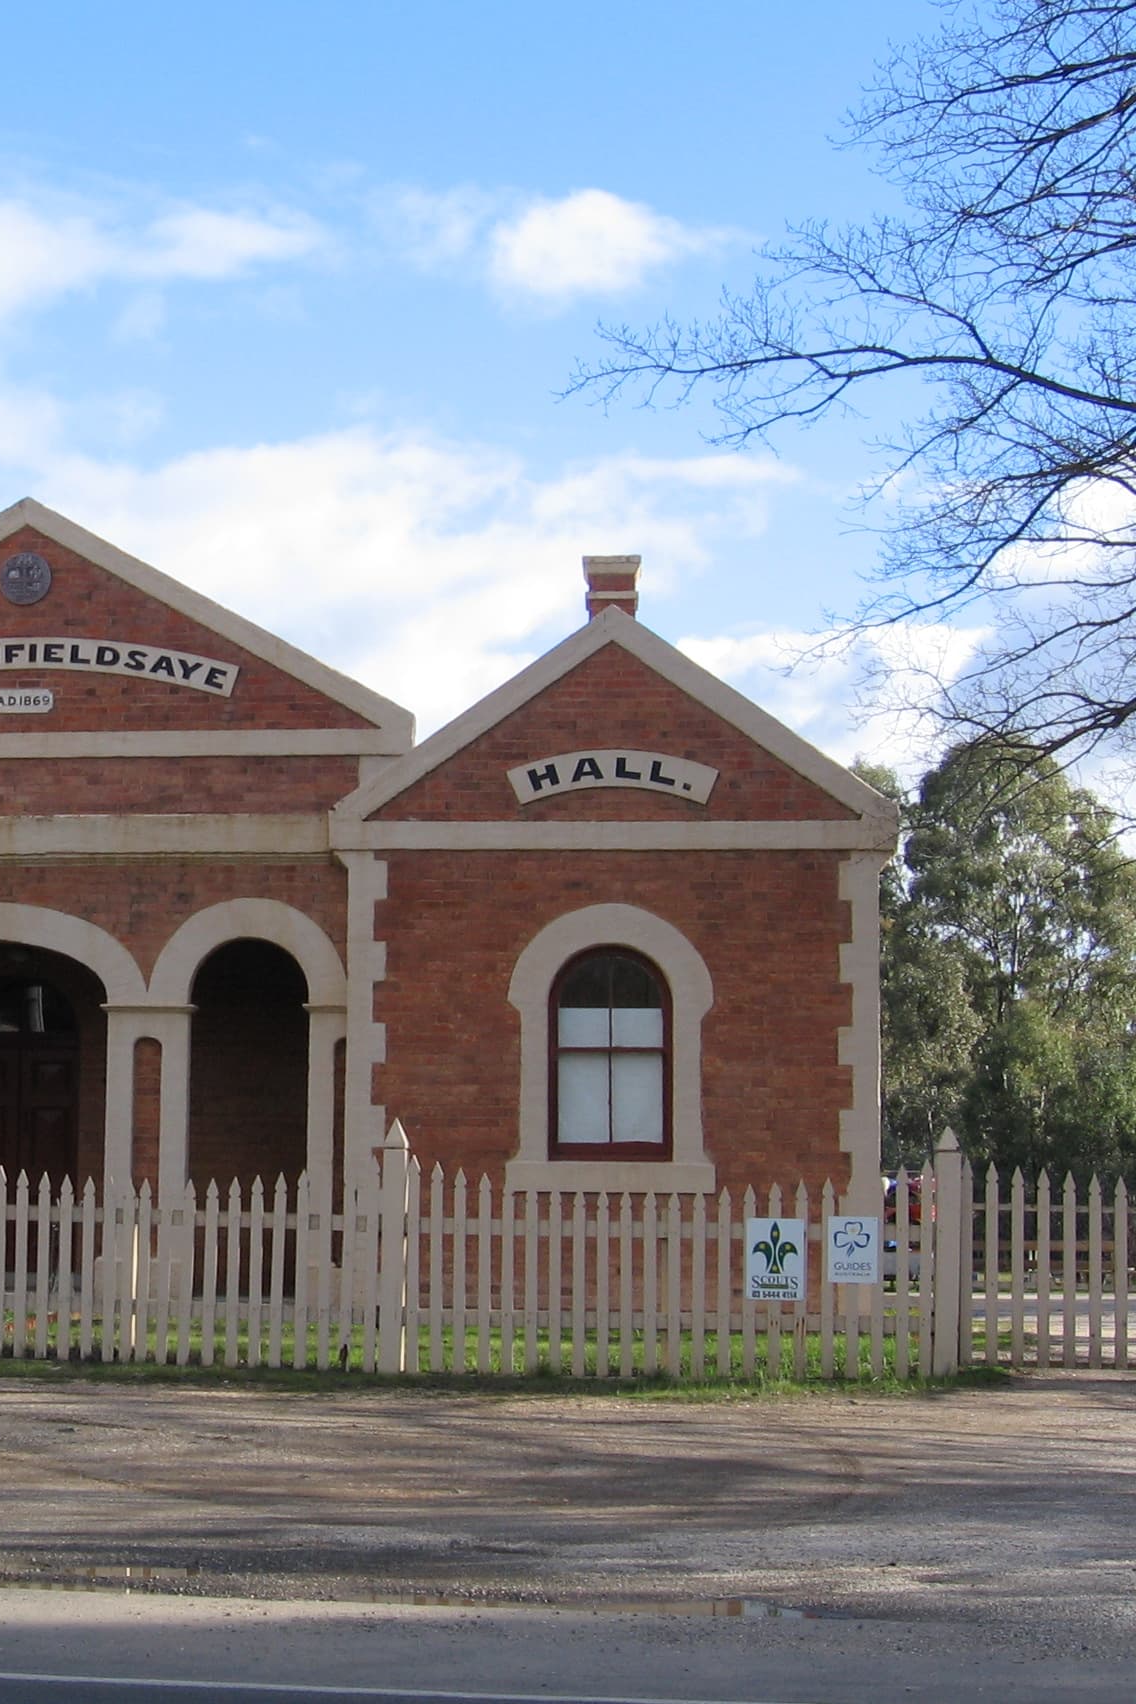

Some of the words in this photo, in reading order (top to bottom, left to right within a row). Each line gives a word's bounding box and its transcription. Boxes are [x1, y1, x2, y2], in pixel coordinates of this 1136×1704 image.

[527, 757, 692, 792] HALL.
[834, 1261, 872, 1271] GUIDES
[751, 1275, 799, 1290] SCOUTS
